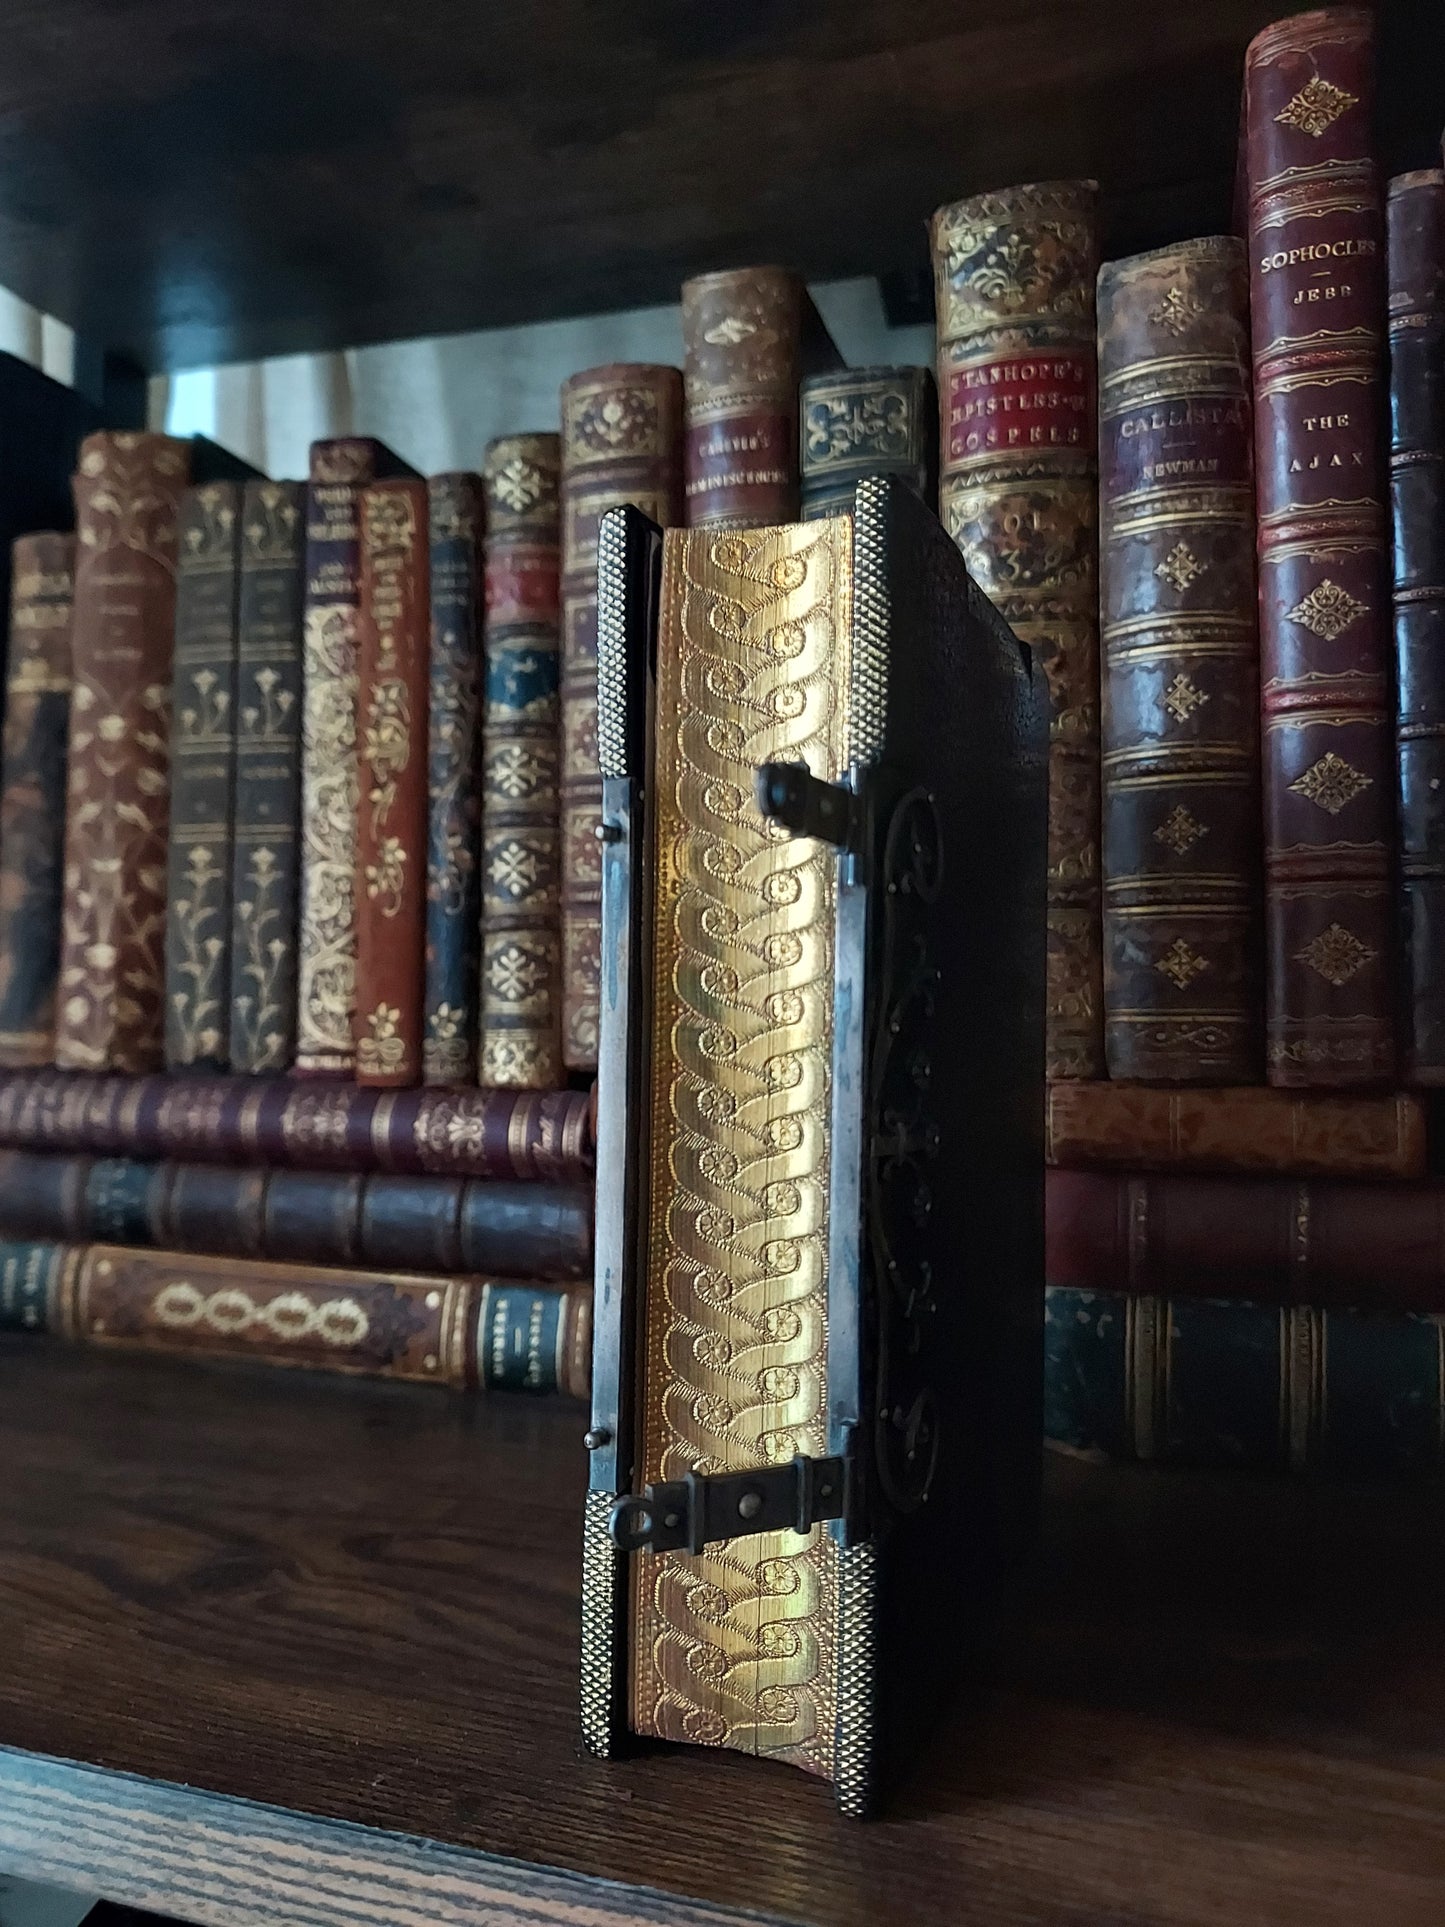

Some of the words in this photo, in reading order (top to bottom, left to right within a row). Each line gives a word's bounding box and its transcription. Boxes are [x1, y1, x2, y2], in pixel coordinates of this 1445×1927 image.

[1260, 239, 1377, 274] SOPHOCLES
[1293, 285, 1352, 305] JEBB
[950, 361, 1084, 392] STANHOPE'S
[1121, 406, 1239, 438] CALLISTA
[1302, 413, 1351, 431] THE
[950, 426, 1080, 455] GOSPELS
[1142, 458, 1219, 481] NEWMAN
[1289, 451, 1364, 474] AJAX
